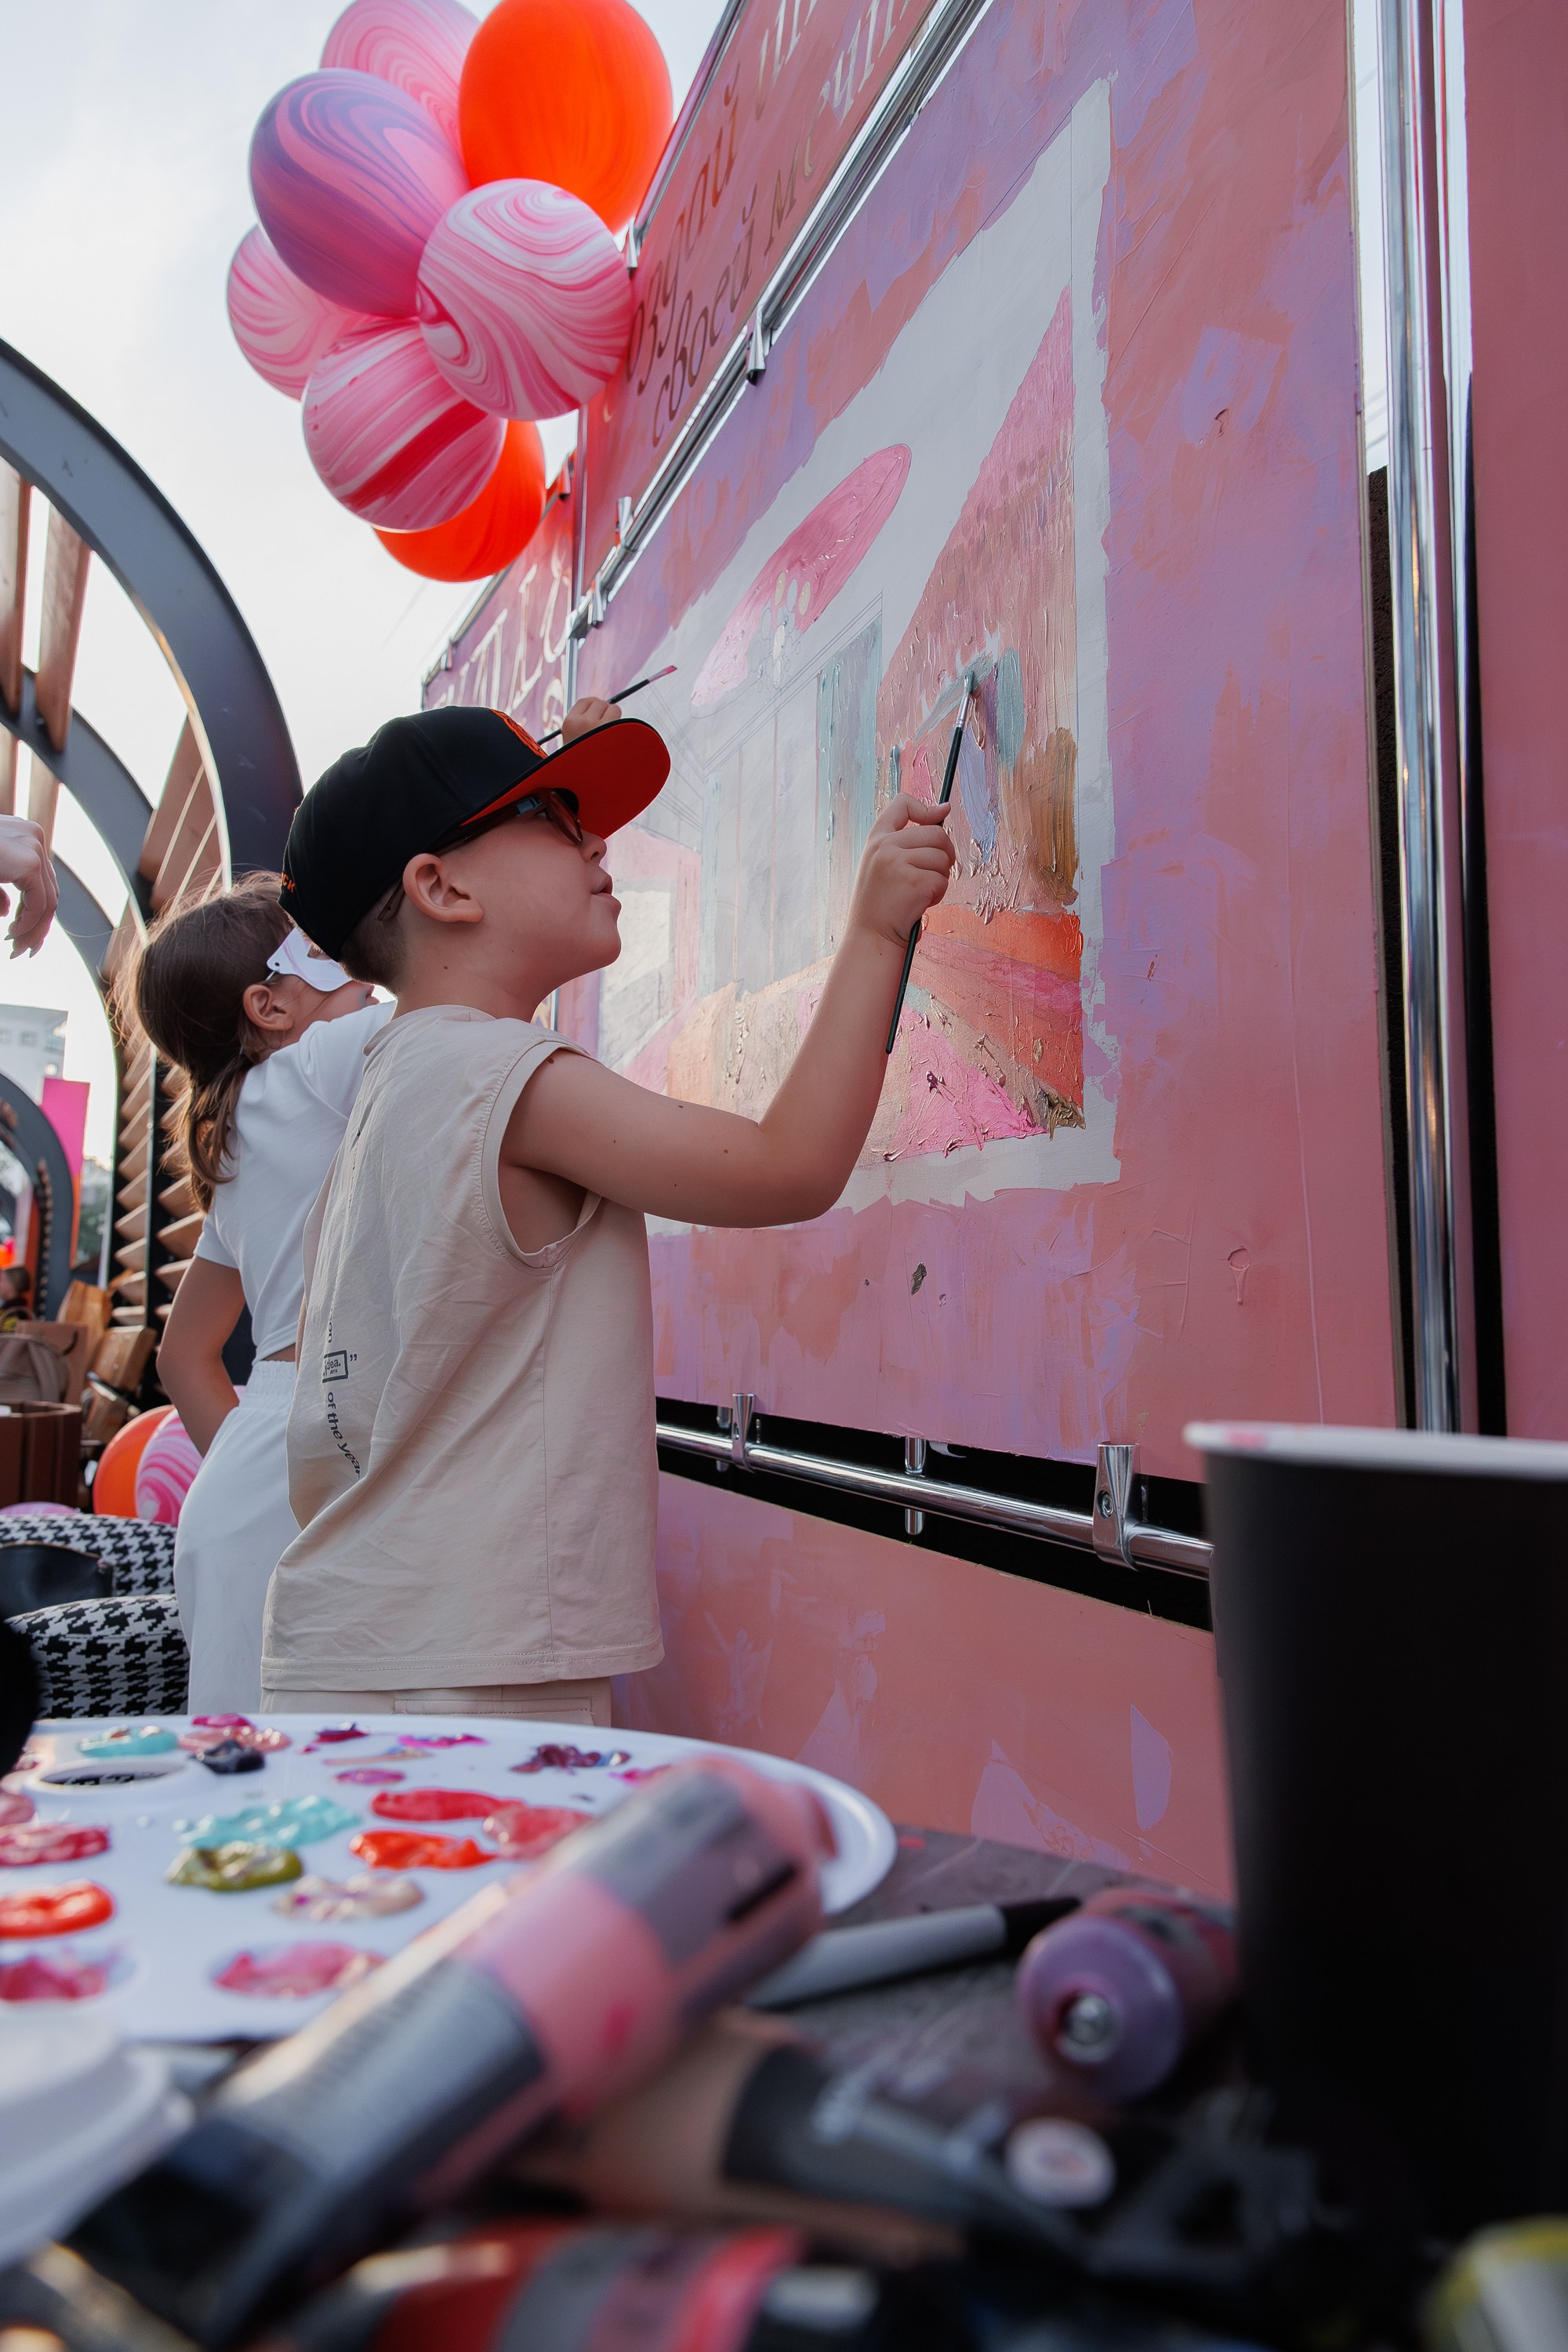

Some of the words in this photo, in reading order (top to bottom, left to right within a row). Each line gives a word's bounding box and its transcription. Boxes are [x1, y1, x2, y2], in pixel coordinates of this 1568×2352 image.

[652, 180, 757, 448] своей
[328, 1392, 336, 1409] of
[328, 1412, 343, 1439] the
[337, 1443, 361, 1479] year
